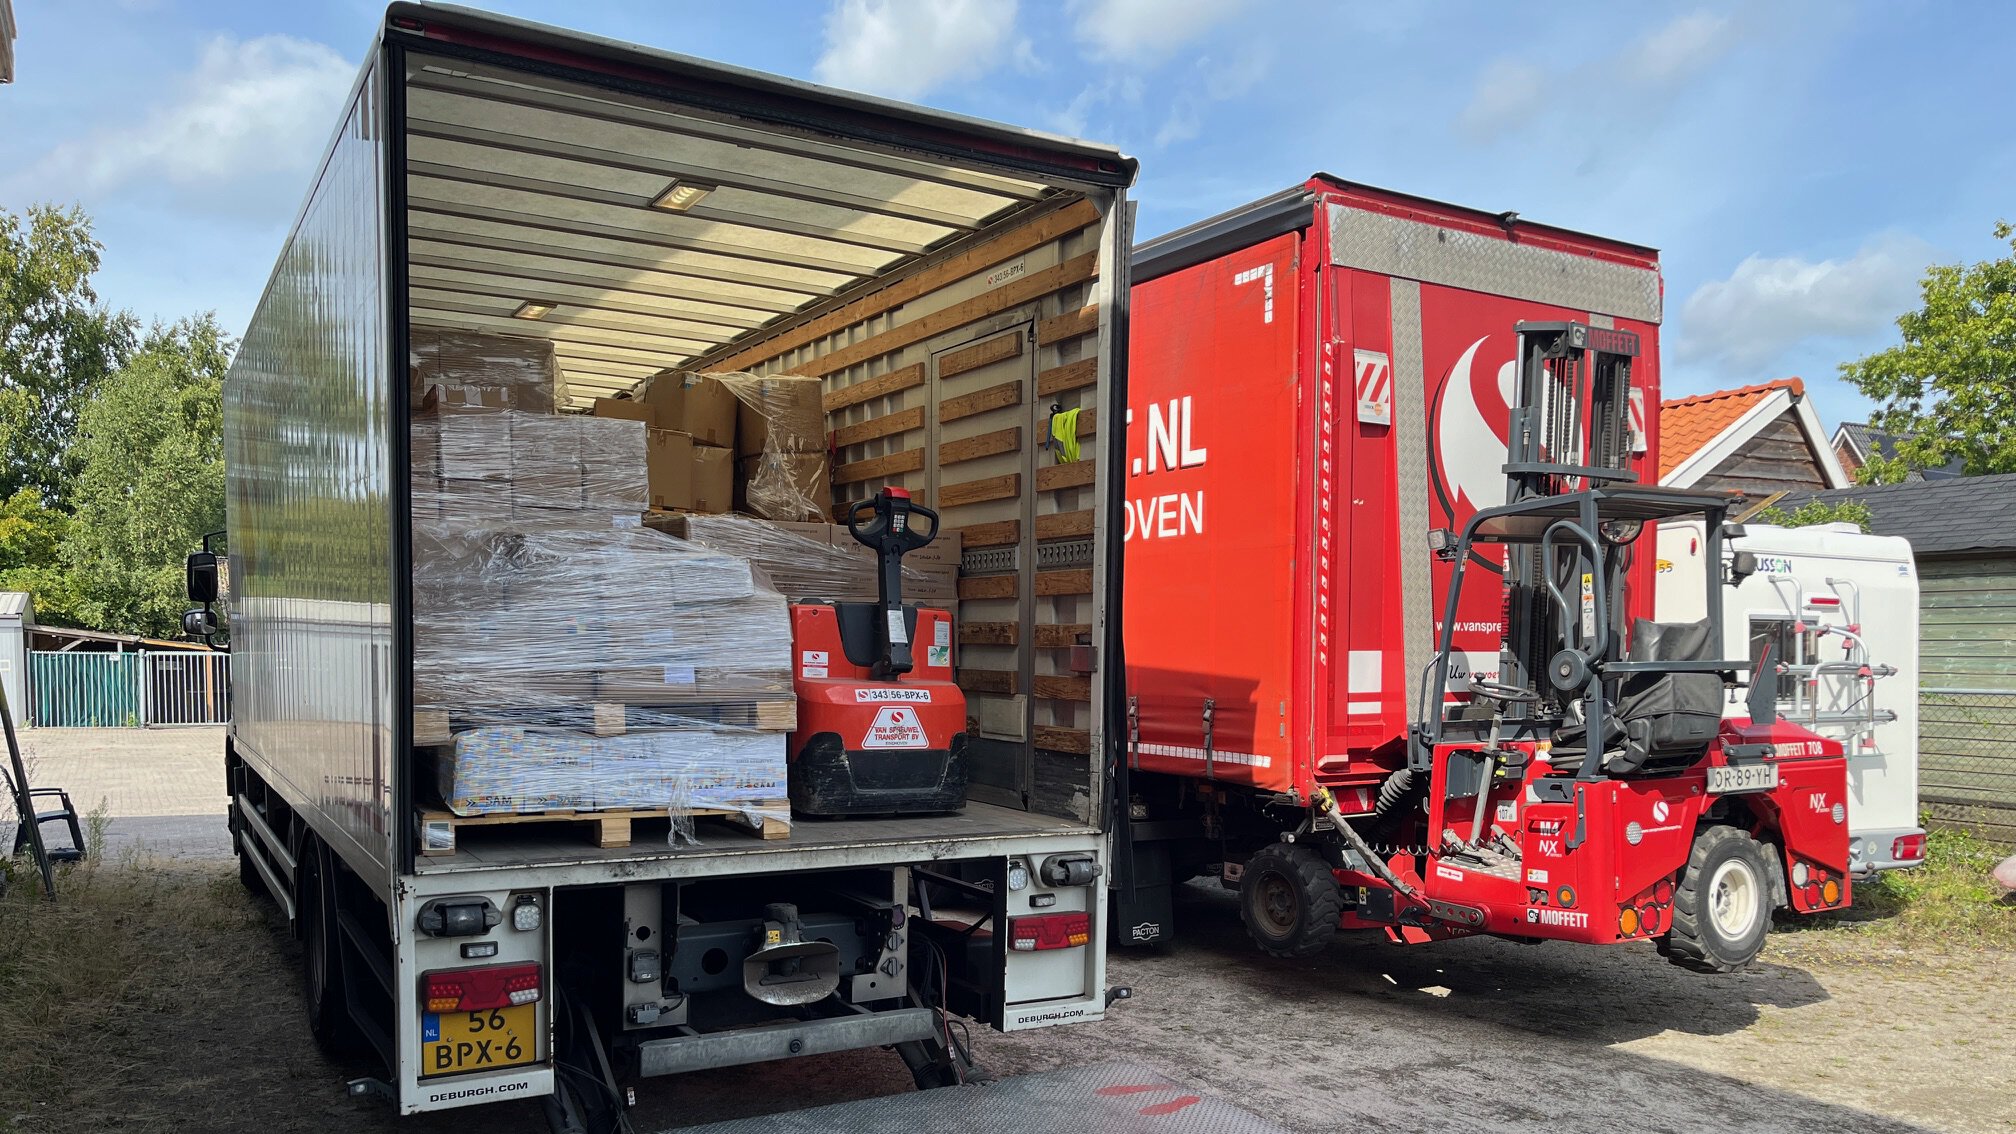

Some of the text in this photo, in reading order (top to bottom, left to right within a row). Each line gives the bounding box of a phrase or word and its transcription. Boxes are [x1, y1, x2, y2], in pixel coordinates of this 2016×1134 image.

[1588, 328, 1636, 354] MOFFETT
[1126, 395, 1207, 477] .NL
[1754, 559, 1792, 573] USSON
[1436, 621, 1502, 635] ww.vanspre
[1450, 664, 1466, 679] Uw
[871, 690, 929, 700] 343 56-BPX-6
[1775, 741, 1824, 757] MOFFETT 708
[485, 796, 512, 806] SAM
[1809, 792, 1827, 814] NX
[1540, 821, 1560, 836] M4
[1539, 839, 1558, 857] NX
[1541, 909, 1589, 928] MOFFETT
[1132, 926, 1160, 936] PACTON
[468, 1008, 506, 1033] 56
[1018, 1010, 1084, 1024] DEBURGH.COM
[425, 1029, 438, 1037] NL
[436, 1036, 522, 1069] BPX-6
[430, 1082, 528, 1102] DEBURGH.COM
